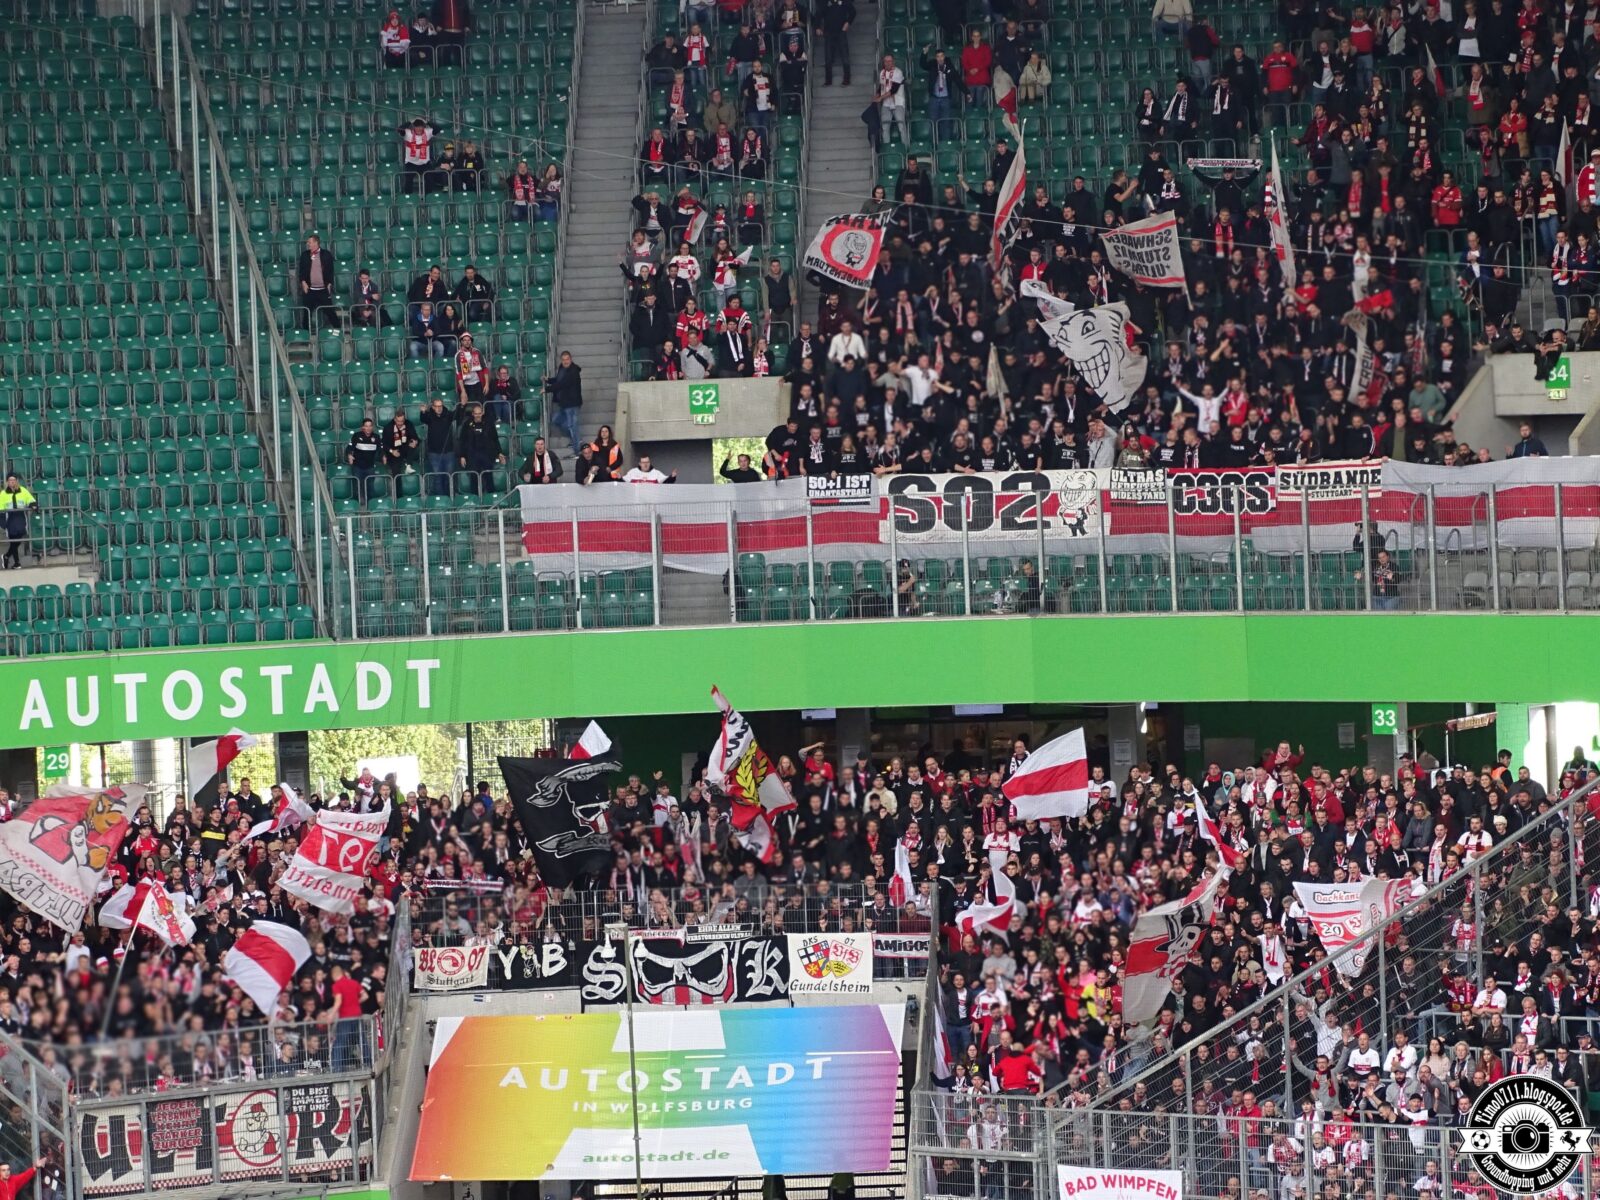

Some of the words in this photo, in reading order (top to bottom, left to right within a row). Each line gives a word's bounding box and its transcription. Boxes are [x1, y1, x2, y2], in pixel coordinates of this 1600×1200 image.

[692, 390, 717, 406] 32
[808, 475, 841, 490] 50+1
[845, 474, 870, 489] IST
[1111, 468, 1164, 483] ULTRAS
[1280, 469, 1382, 490] SÜDBANDE
[1111, 482, 1165, 492] BEDEUTET
[1311, 489, 1353, 499] STUTTGART
[1110, 491, 1166, 501] WIDERSTAND
[19, 659, 441, 730] AUTOSTADT
[1374, 709, 1396, 727] 33
[47, 753, 69, 770] 29
[802, 936, 819, 947] DKS
[844, 937, 855, 946] 07
[468, 946, 487, 972] 07
[426, 974, 475, 988] Stuttgart
[790, 979, 870, 993] Gundelsheim
[499, 1057, 832, 1093] AUTOSTADT
[292, 1089, 305, 1097] DU
[309, 1087, 329, 1095] BIST
[573, 1101, 598, 1113] IN
[610, 1097, 753, 1114] WOLFSBURG
[582, 1149, 731, 1163] autostadt.de
[1065, 1176, 1097, 1196] BAD
[1101, 1174, 1178, 1200] WIMPFEN
